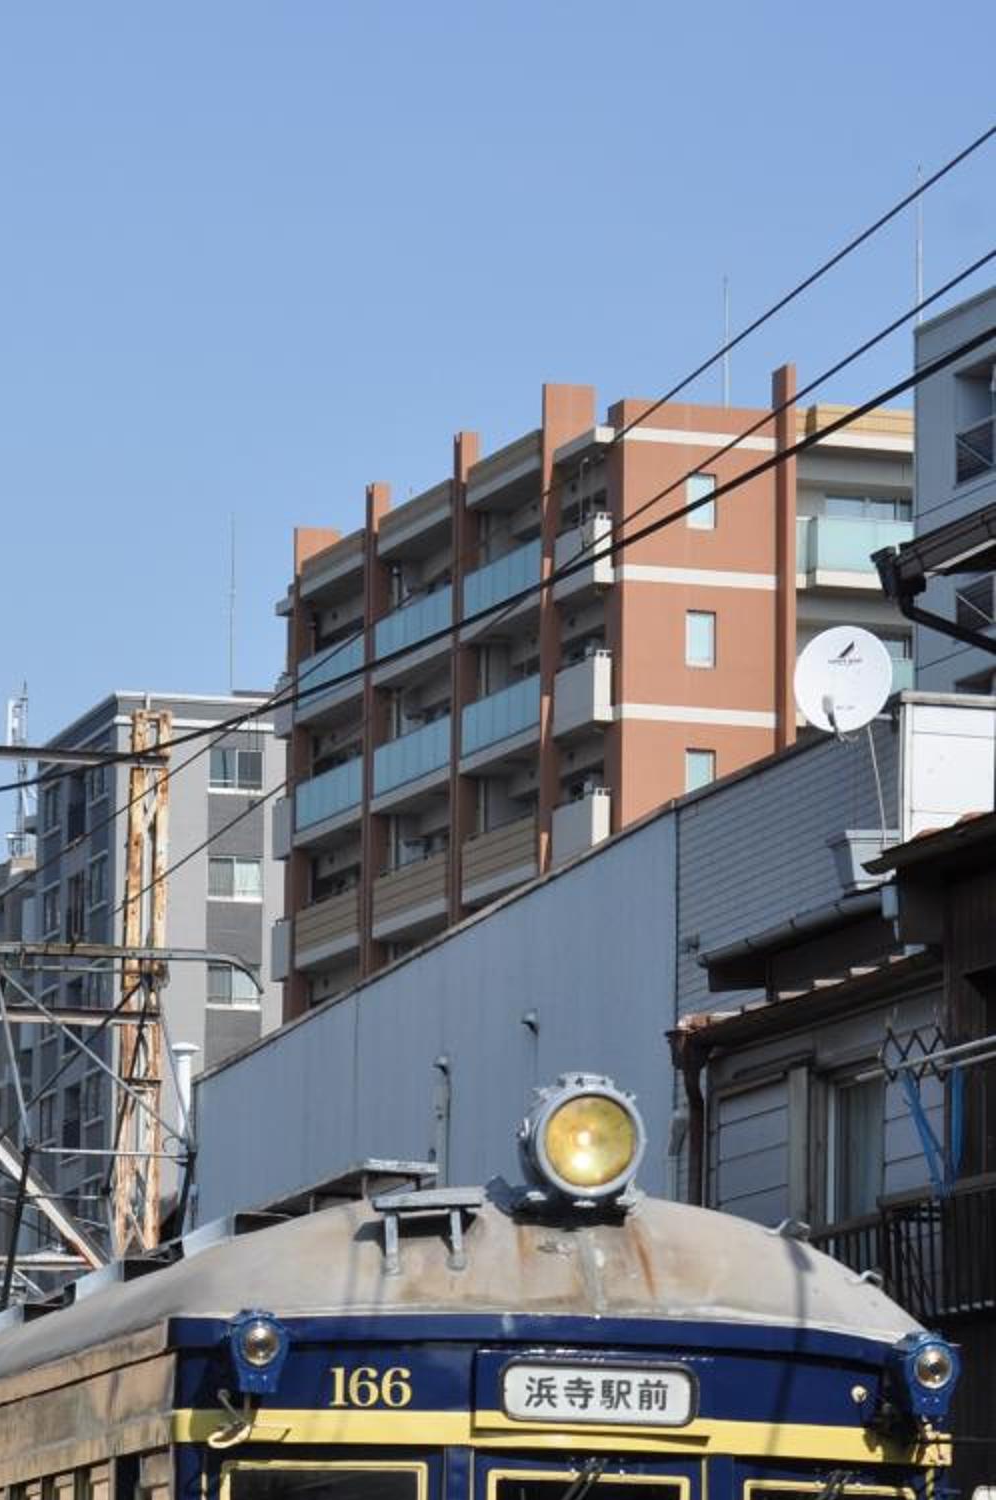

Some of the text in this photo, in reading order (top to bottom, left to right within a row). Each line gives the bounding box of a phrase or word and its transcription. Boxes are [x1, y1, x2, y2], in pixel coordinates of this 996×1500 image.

[329, 1367, 412, 1407] 166
[524, 1375, 669, 1411] 浜寺駅前
